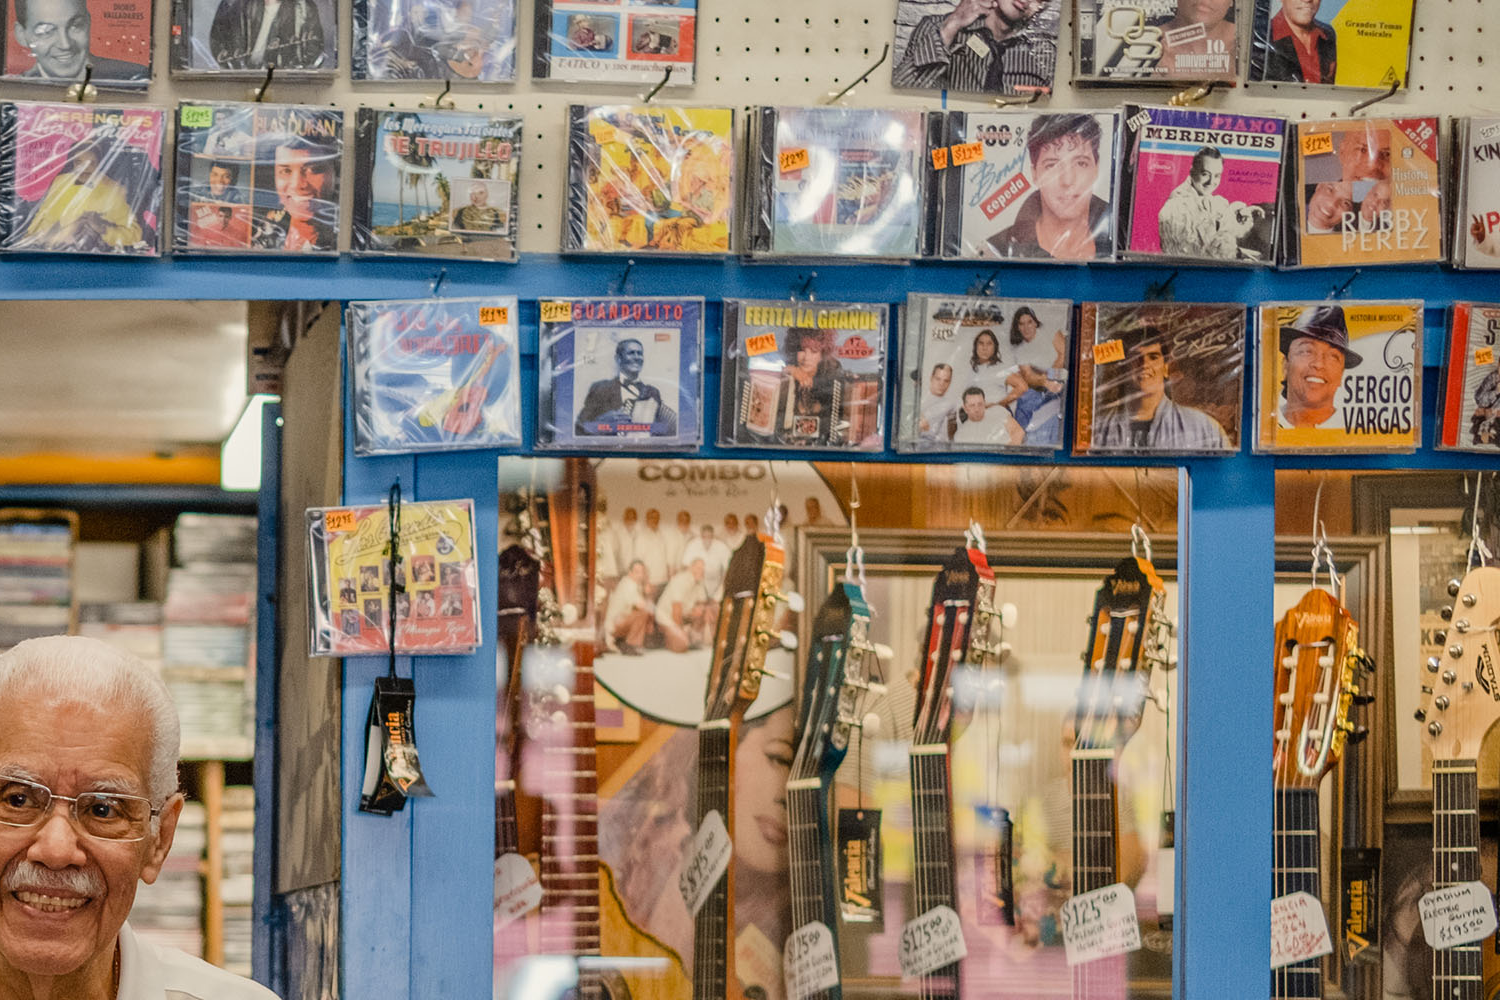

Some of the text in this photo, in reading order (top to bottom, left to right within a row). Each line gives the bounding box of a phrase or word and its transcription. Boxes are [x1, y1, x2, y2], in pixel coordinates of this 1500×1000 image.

[1345, 20, 1403, 31] Grandes Temas
[1357, 29, 1393, 39] Musicales
[558, 58, 600, 70] TATICO
[1175, 53, 1230, 73] anniversary
[288, 111, 336, 137] DURAN
[1211, 116, 1277, 134] PIANO
[1418, 120, 1434, 140] 18
[1145, 126, 1276, 149] MERENGUES
[1304, 134, 1331, 153] $1295
[417, 138, 513, 162] TRUJILLO
[779, 150, 805, 169] $1295
[1341, 208, 1429, 233] RUBBY
[1341, 229, 1430, 252] PEREZ
[573, 303, 684, 321] GUANDULITO
[745, 306, 880, 331] FEFITA LA GRANDE
[1350, 313, 1404, 323] HISTORIA MUSICAL
[1343, 374, 1412, 405] SERGIO
[1343, 405, 1412, 436] VARGAS
[638, 464, 768, 482] COMBO
[327, 513, 352, 529] $1295
[1448, 905, 1487, 922] GUITAR
